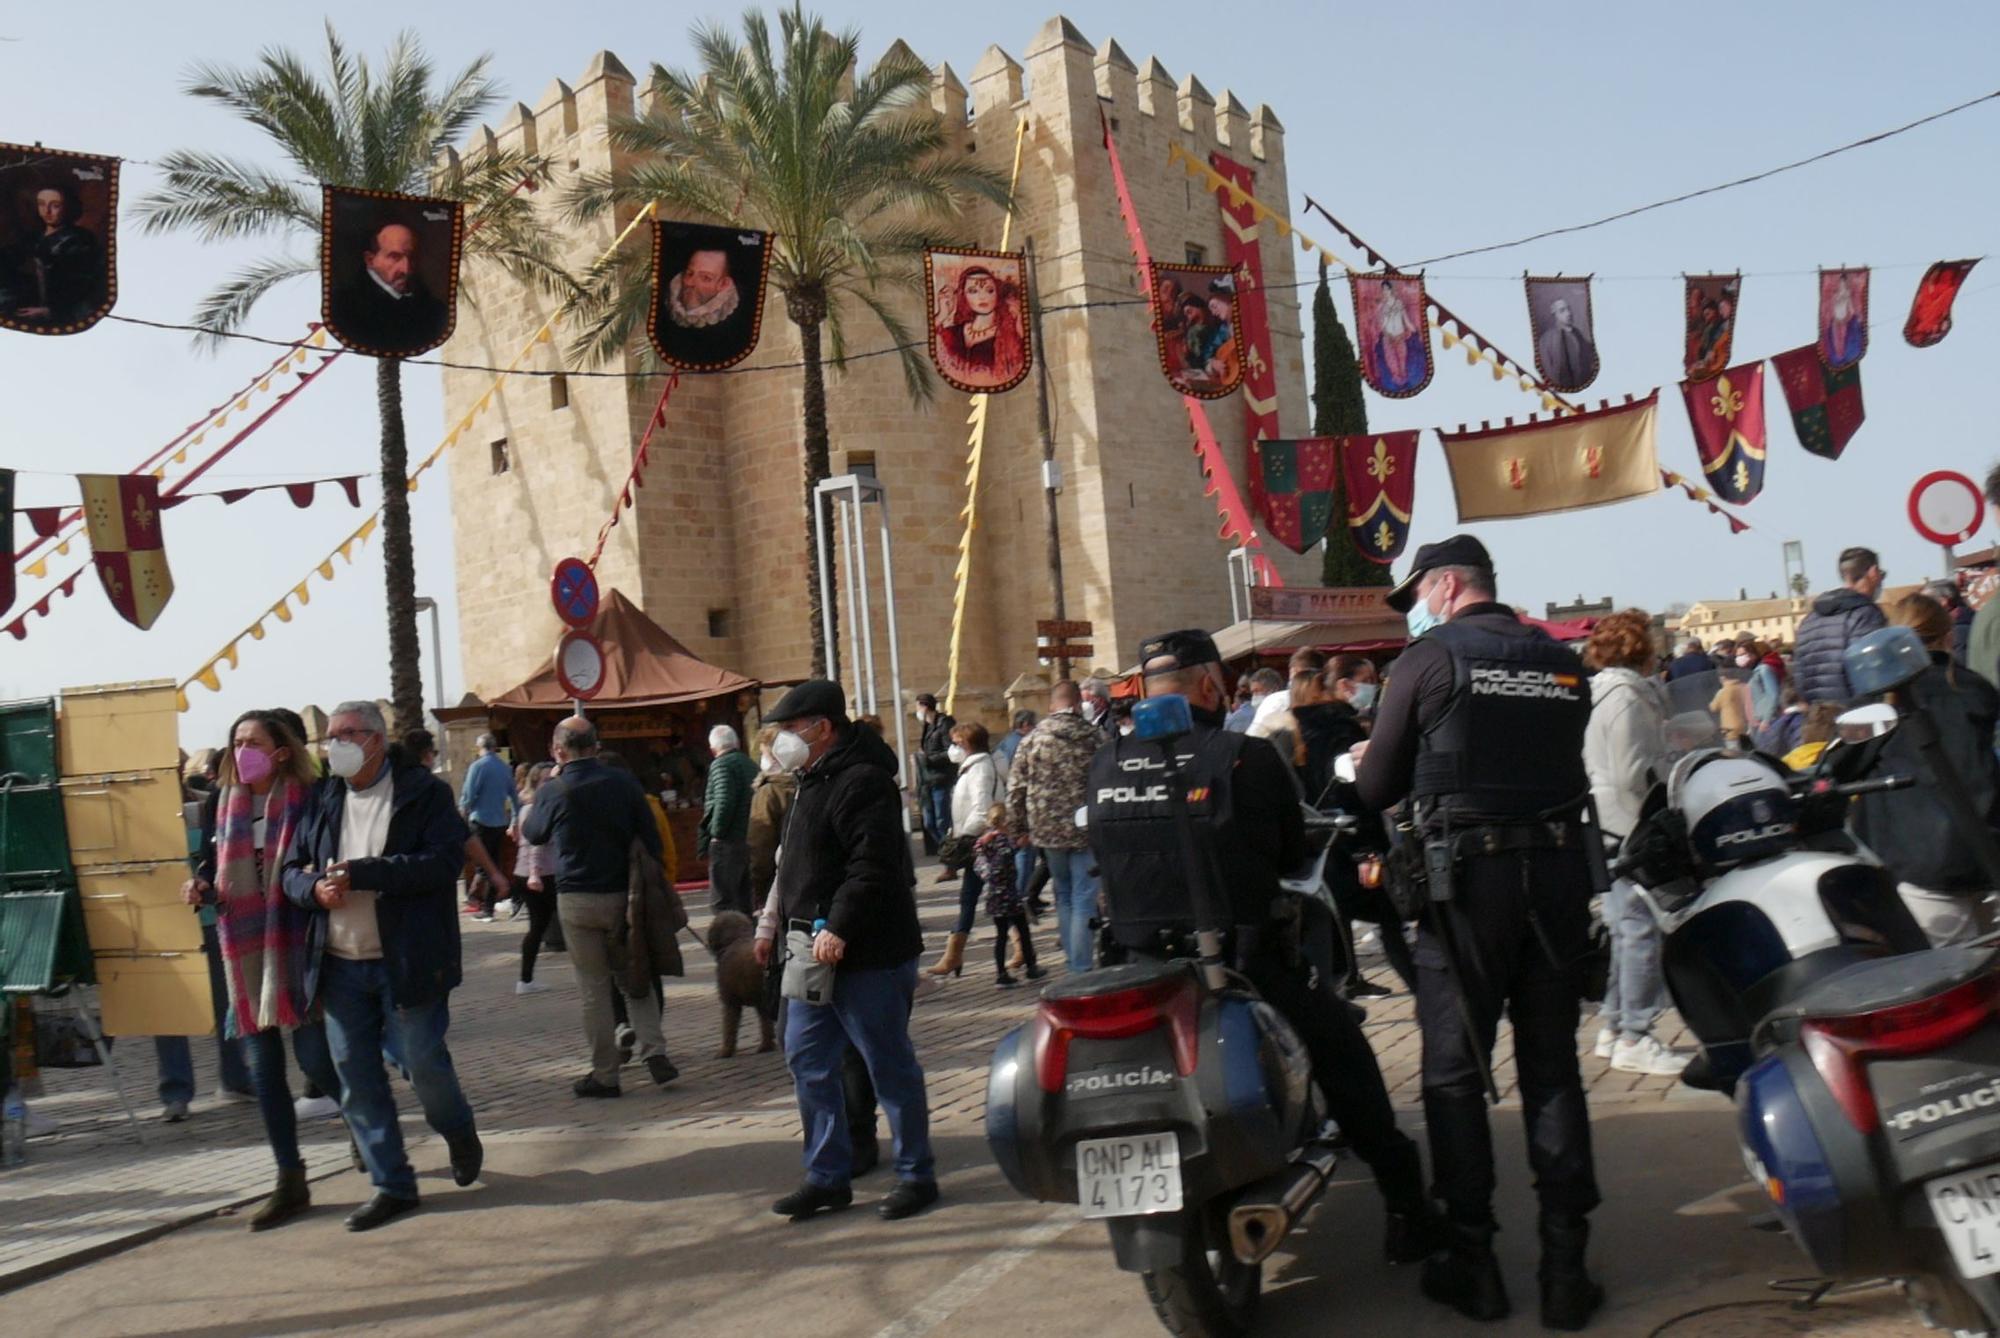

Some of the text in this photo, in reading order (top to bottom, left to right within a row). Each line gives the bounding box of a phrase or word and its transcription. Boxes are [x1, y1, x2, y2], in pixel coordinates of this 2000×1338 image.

[1470, 669, 1557, 686] POLICIA
[1472, 681, 1580, 700] NACIONAL
[1097, 785, 1170, 804] POLIC
[1083, 1143, 1134, 1175] CNP
[1091, 1174, 1169, 1209] 4173
